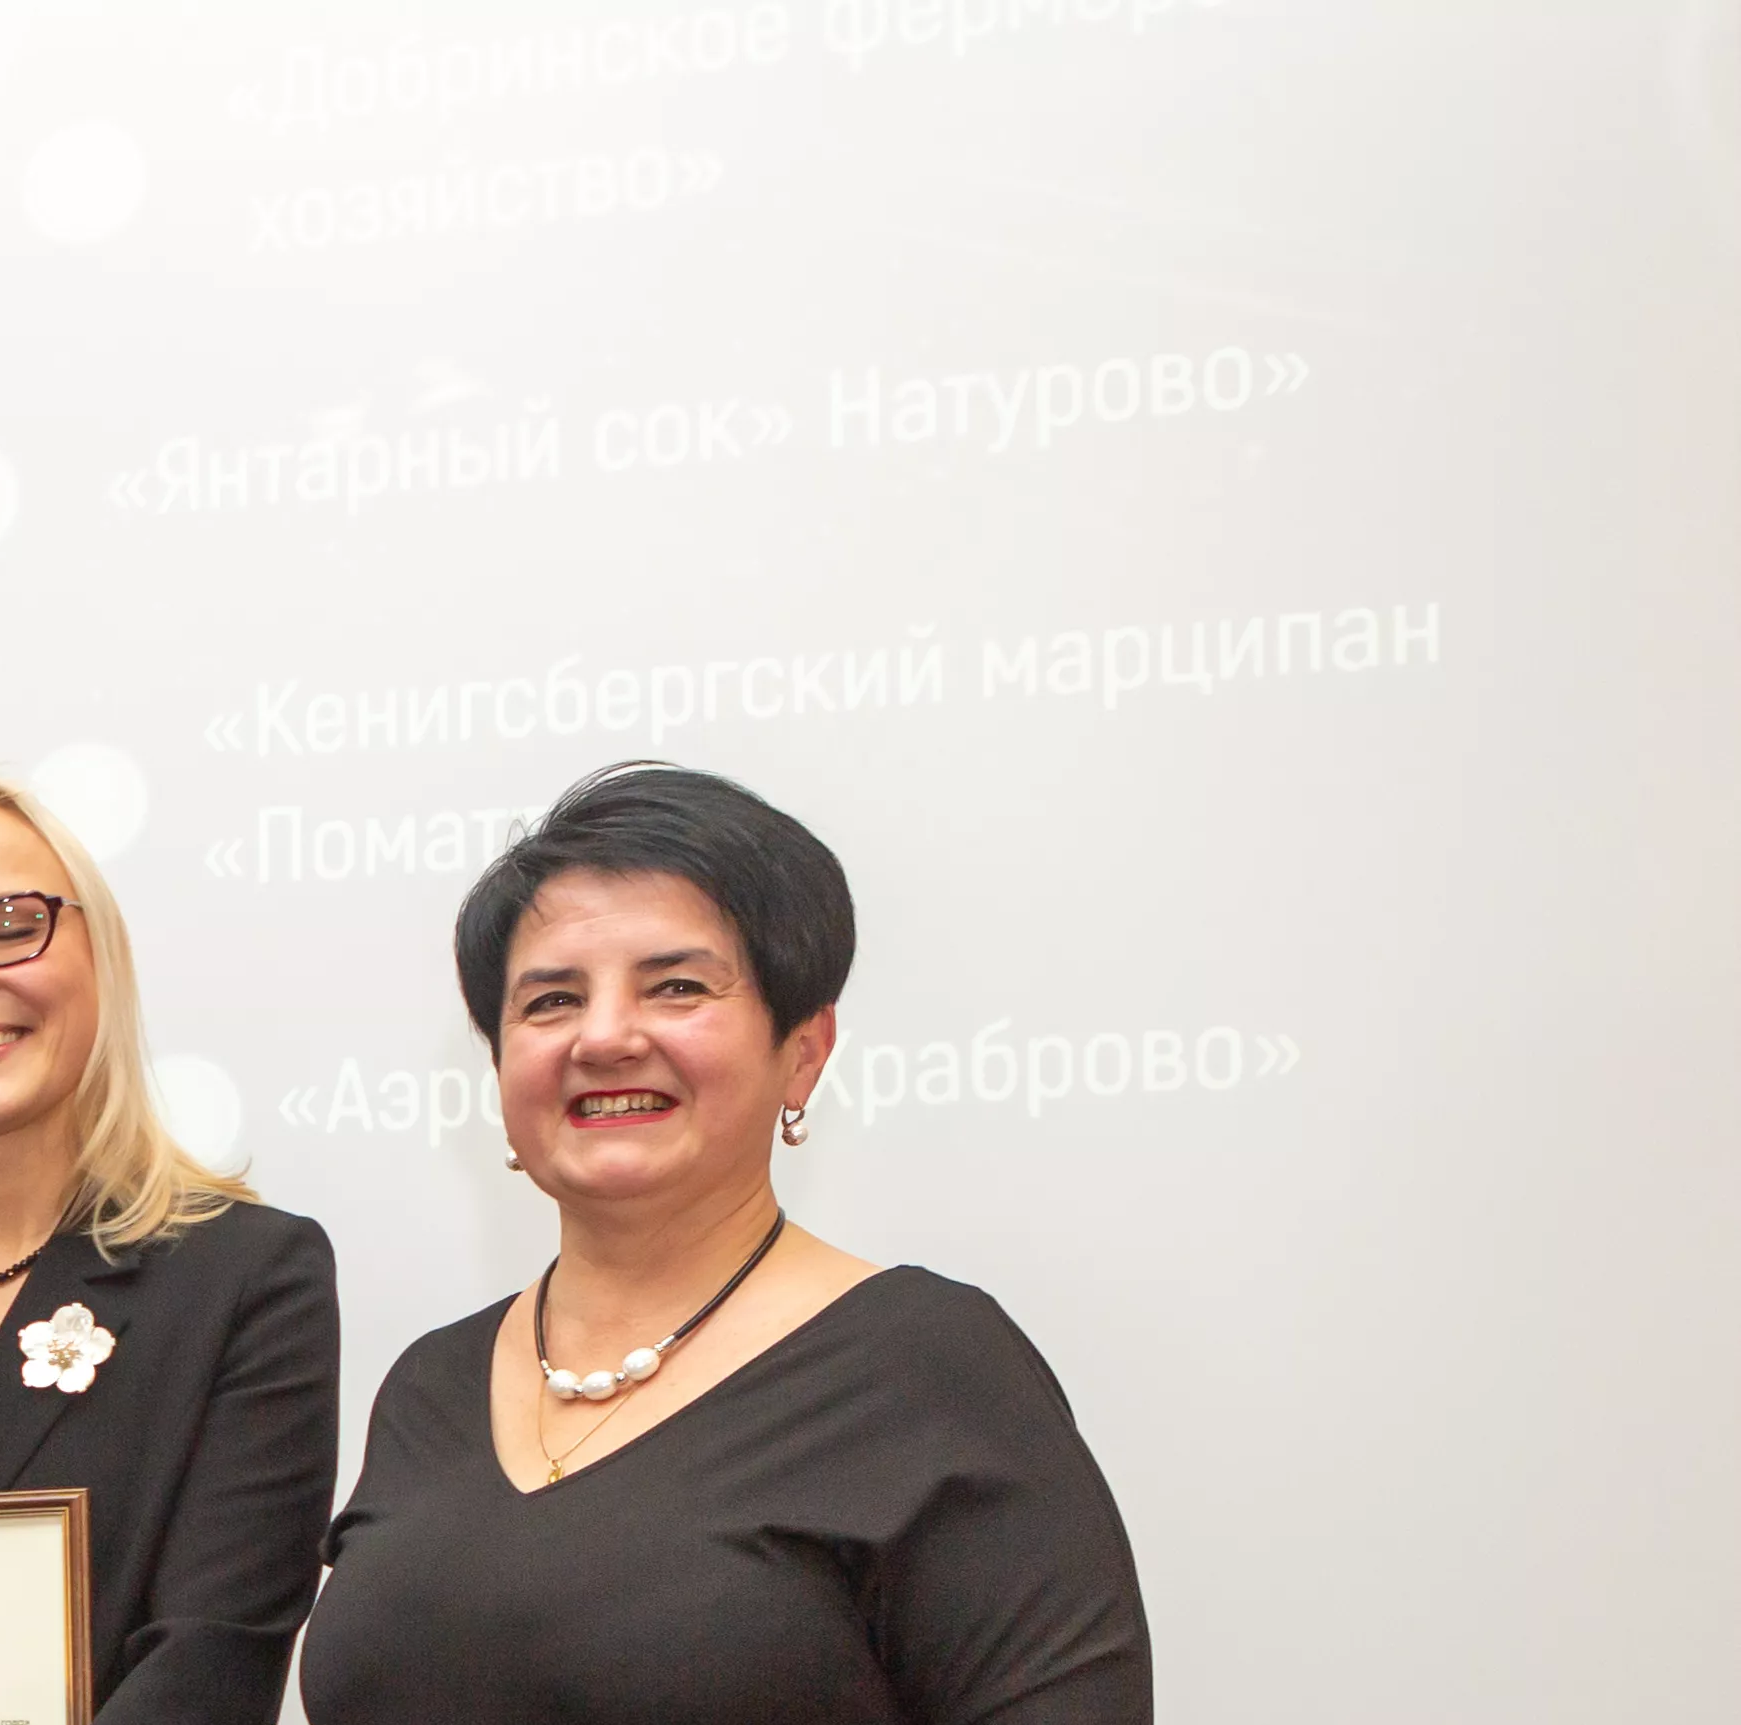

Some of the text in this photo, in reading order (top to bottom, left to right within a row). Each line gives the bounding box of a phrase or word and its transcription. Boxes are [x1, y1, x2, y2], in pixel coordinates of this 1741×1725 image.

[106, 346, 1312, 516] «Янтарный сок» Натурово»
[202, 601, 1444, 757] «Кенигсбергский марципан
